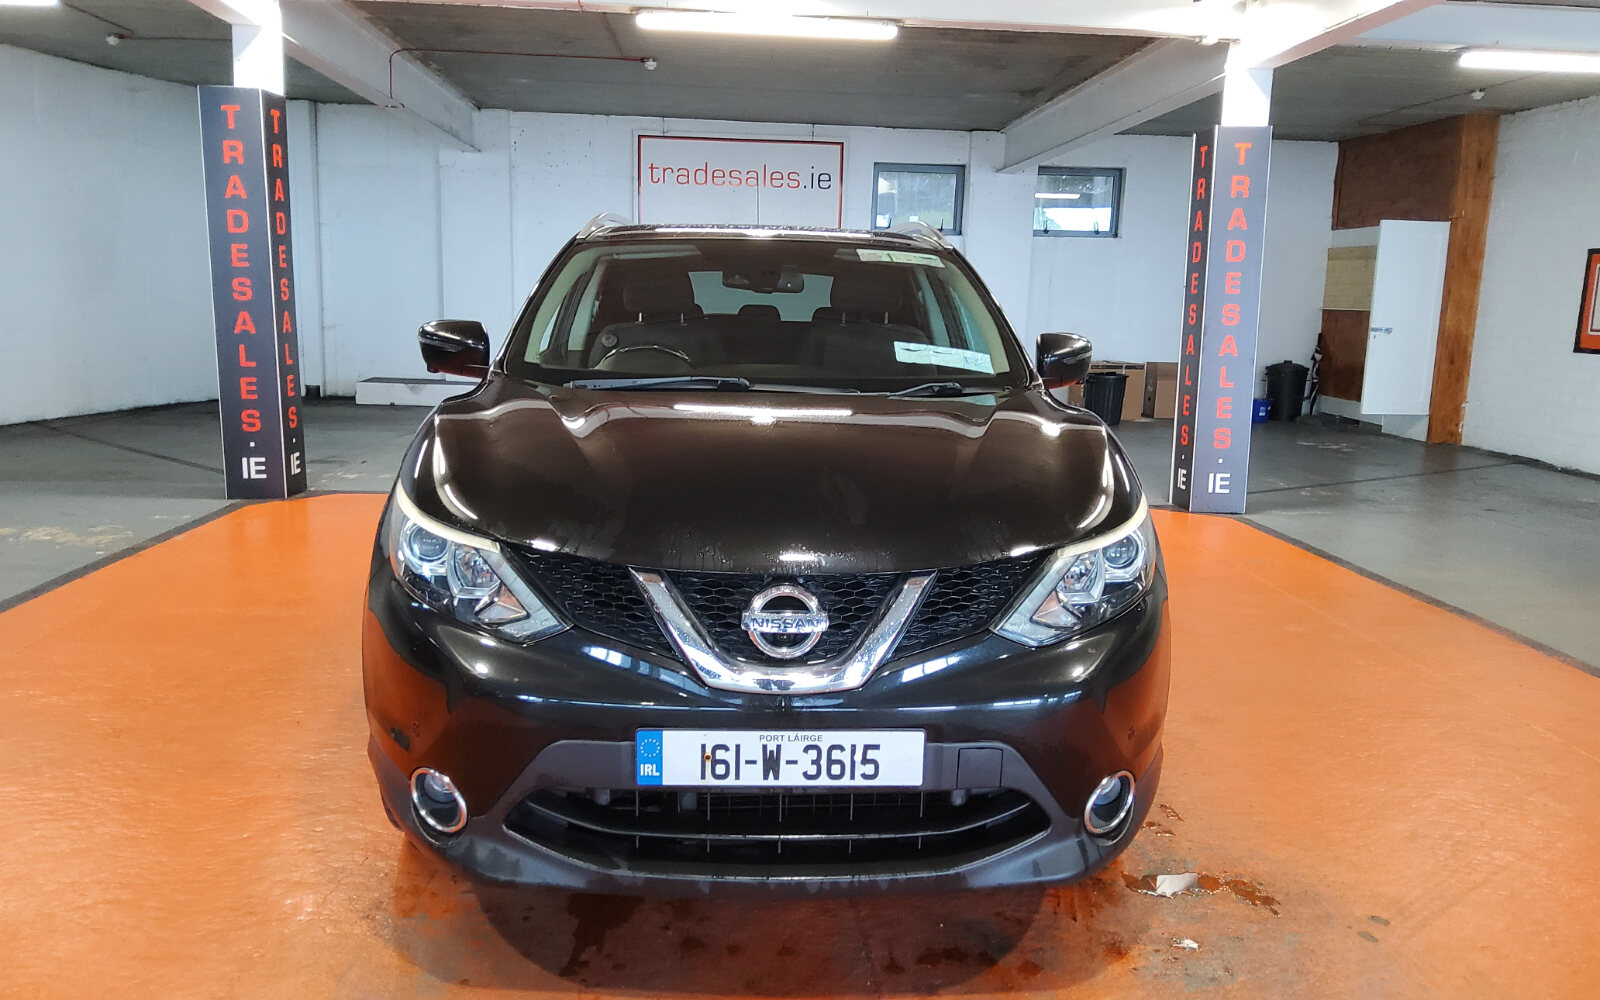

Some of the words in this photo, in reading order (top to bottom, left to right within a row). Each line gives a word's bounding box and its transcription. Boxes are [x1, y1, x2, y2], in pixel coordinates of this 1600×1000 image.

[648, 162, 832, 190] tradesales.ie
[751, 617, 822, 629] NISSAN
[759, 734, 786, 742] PORT
[788, 733, 823, 742] LÁIRGE
[700, 744, 880, 780] 161-W-3615
[640, 764, 660, 776] IRL
